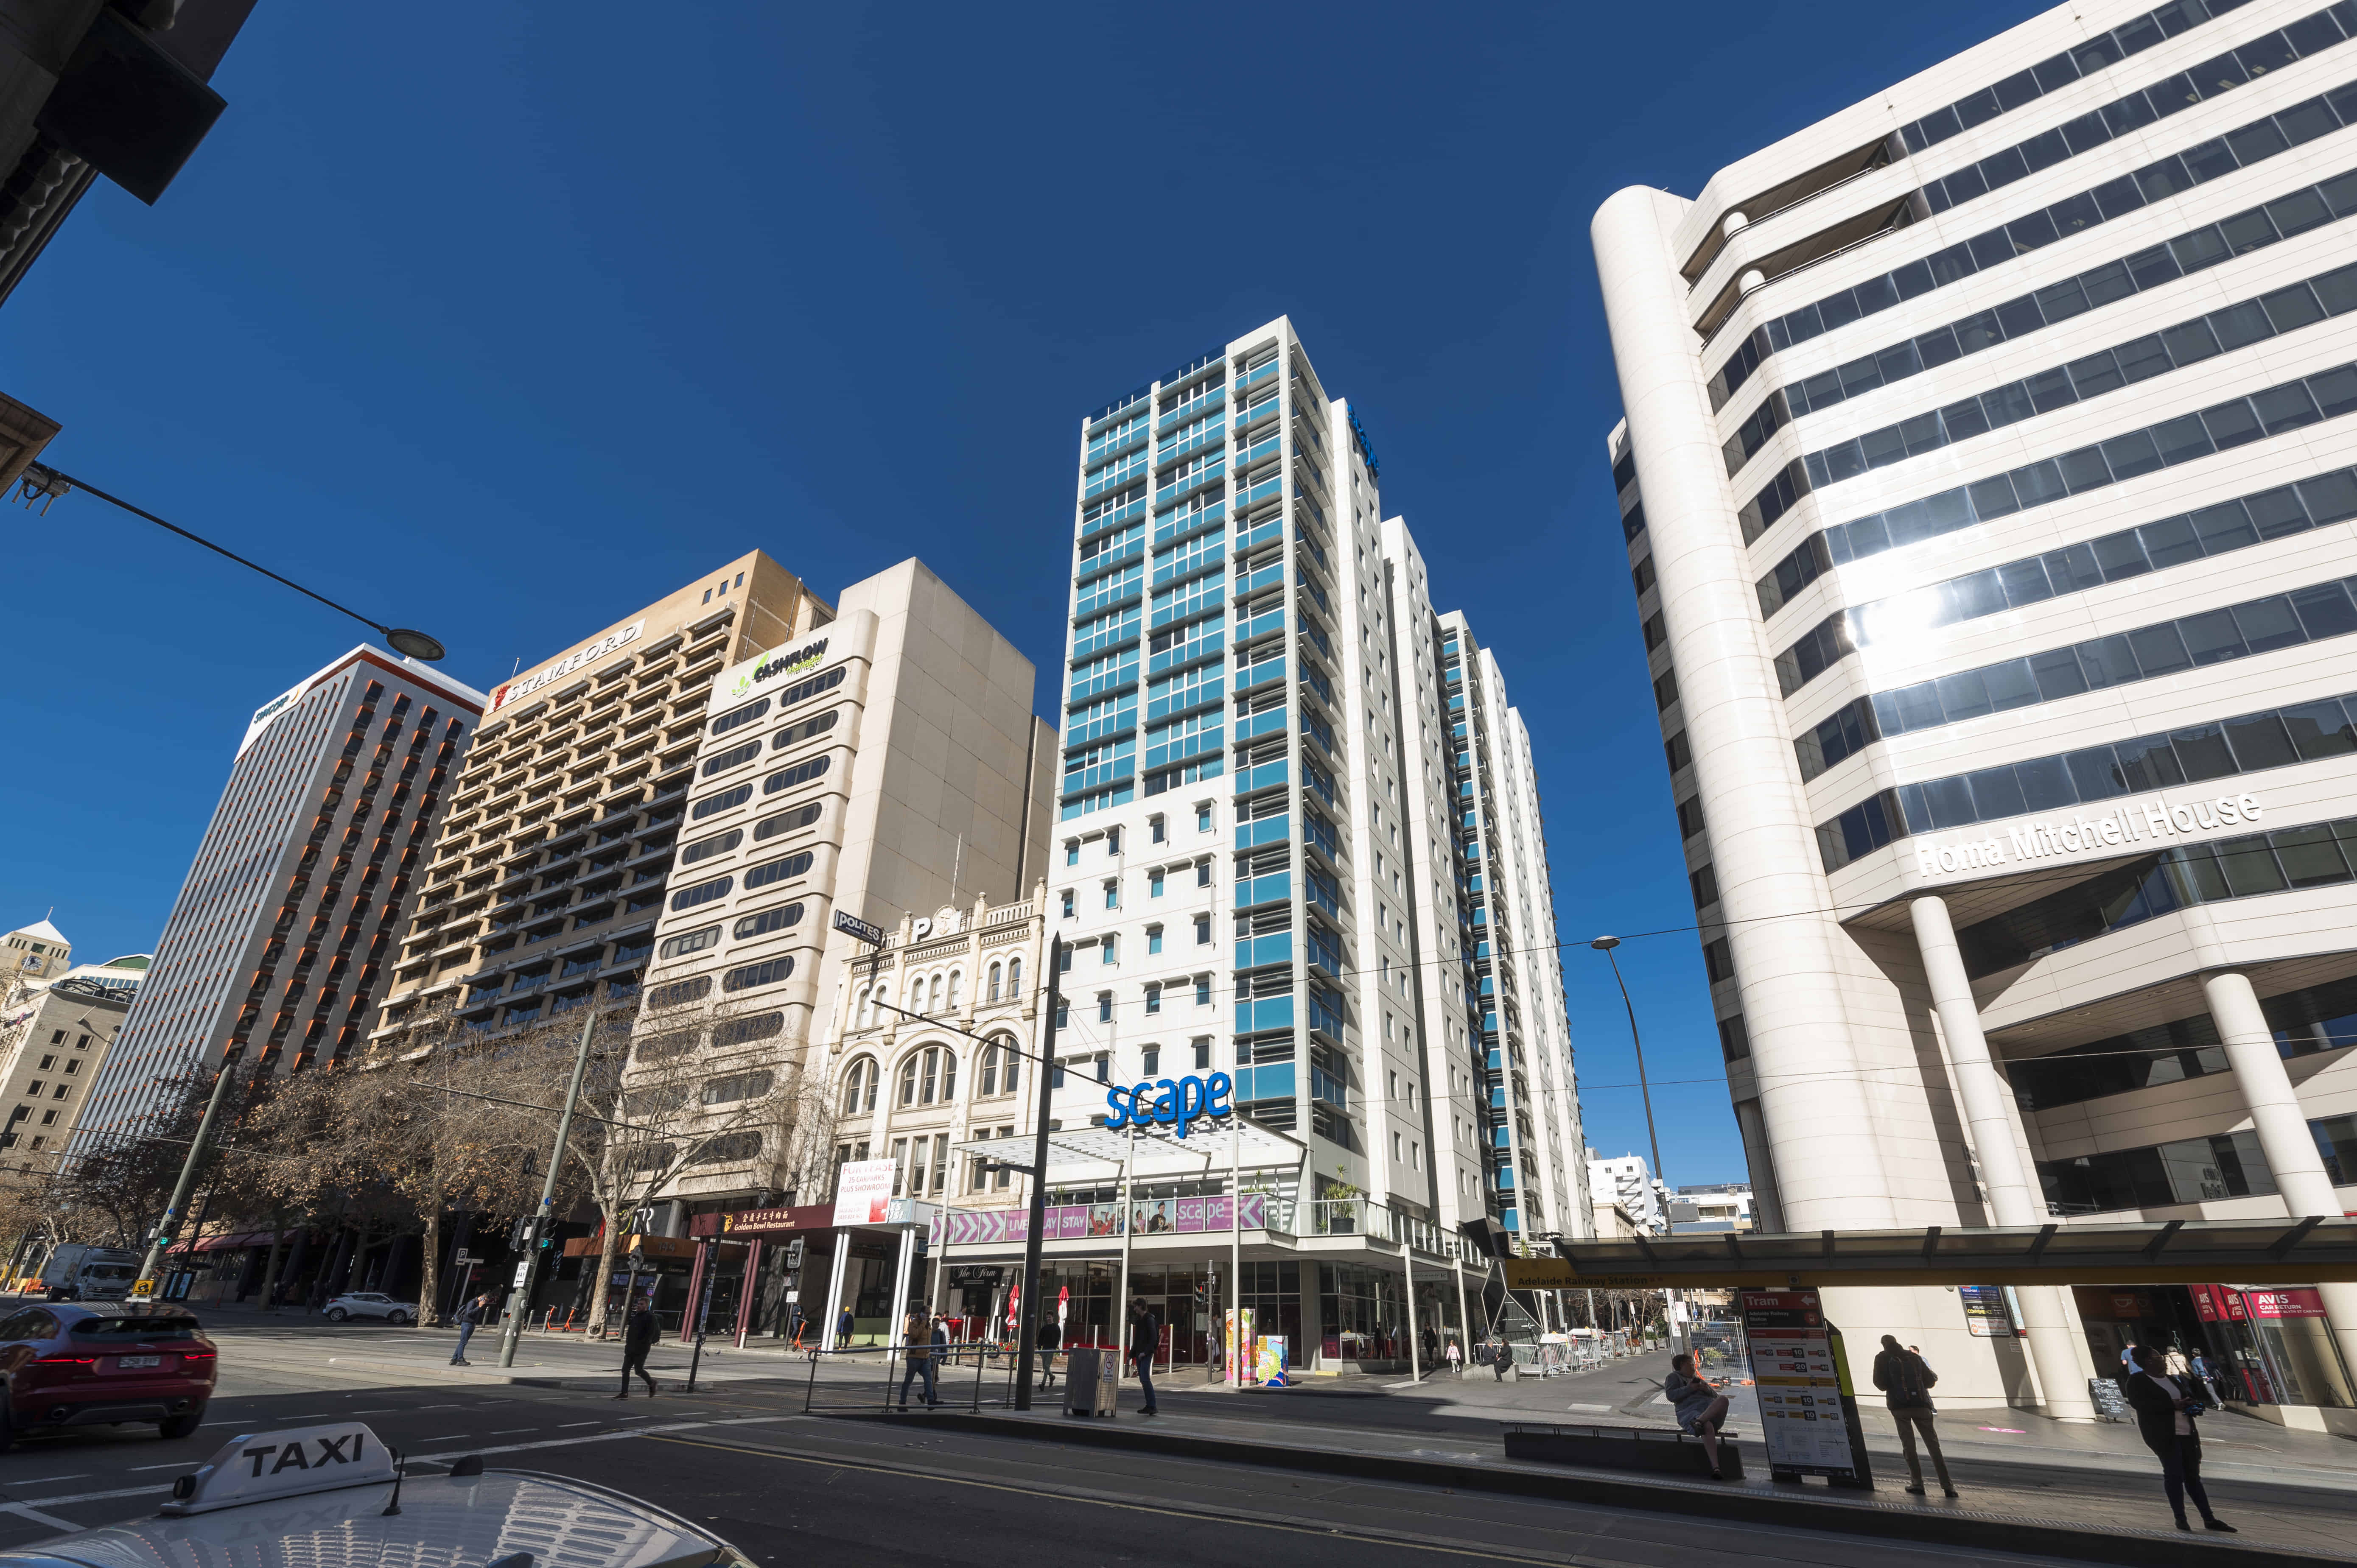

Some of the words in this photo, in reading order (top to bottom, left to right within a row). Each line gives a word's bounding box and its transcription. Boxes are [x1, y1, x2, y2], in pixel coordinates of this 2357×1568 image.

[509, 625, 637, 701] STAMFORD
[753, 637, 829, 683] CASHFLOW
[786, 653, 823, 677] manager
[1914, 839, 2005, 877] Roma
[2008, 807, 2140, 861] Mitchell
[2141, 793, 2263, 838] House
[839, 914, 879, 941] POLITES
[1104, 1072, 1231, 1140] scape
[856, 1174, 885, 1183] CARPARKS
[855, 1183, 890, 1191] SHOWROOM
[1178, 1202, 1224, 1225] scape
[767, 1220, 795, 1228] Restaurant
[1043, 1217, 1058, 1230] AY
[1062, 1216, 1085, 1229] STAY
[658, 1241, 676, 1252] 144
[953, 1265, 971, 1279] The
[972, 1265, 997, 1279] Firm
[1518, 1277, 1562, 1286] Adelaide
[1565, 1277, 1606, 1287] Railway
[1608, 1276, 1648, 1285] Station
[1746, 1296, 1779, 1306] Tram
[2199, 1293, 2210, 1304] AVIS
[2227, 1294, 2239, 1305] AVIS
[2258, 1294, 2289, 1304] AVIS
[242, 1433, 364, 1478] TAXI
